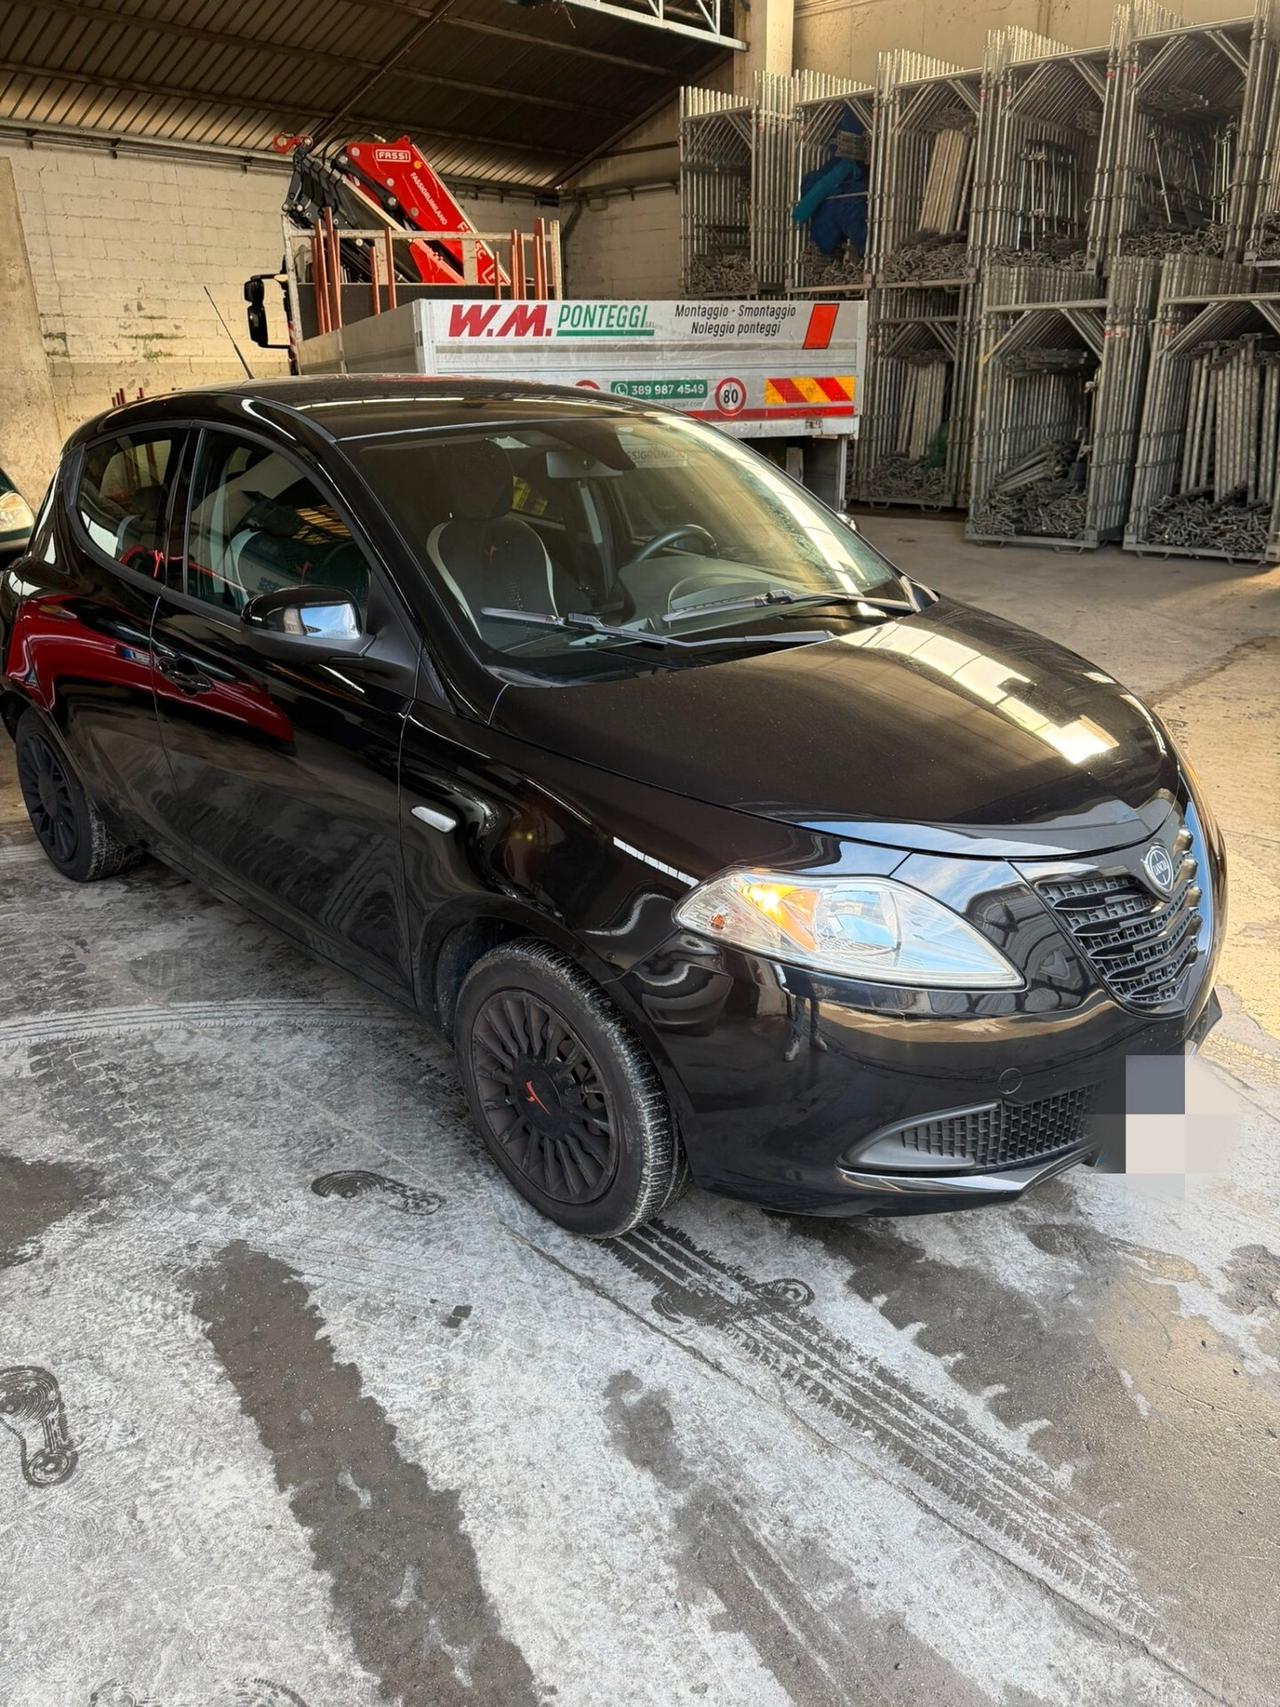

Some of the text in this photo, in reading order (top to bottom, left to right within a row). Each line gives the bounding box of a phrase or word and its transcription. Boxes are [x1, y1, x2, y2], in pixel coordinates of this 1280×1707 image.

[379, 151, 408, 160] FASSI
[675, 304, 729, 320] Montaggio
[738, 304, 796, 320] Smontaggio
[448, 304, 649, 337] W.M. PONTEGGI
[691, 321, 781, 337] Noleggio ponteggi
[631, 384, 705, 395] 389 987 4549
[723, 389, 739, 404] 80
